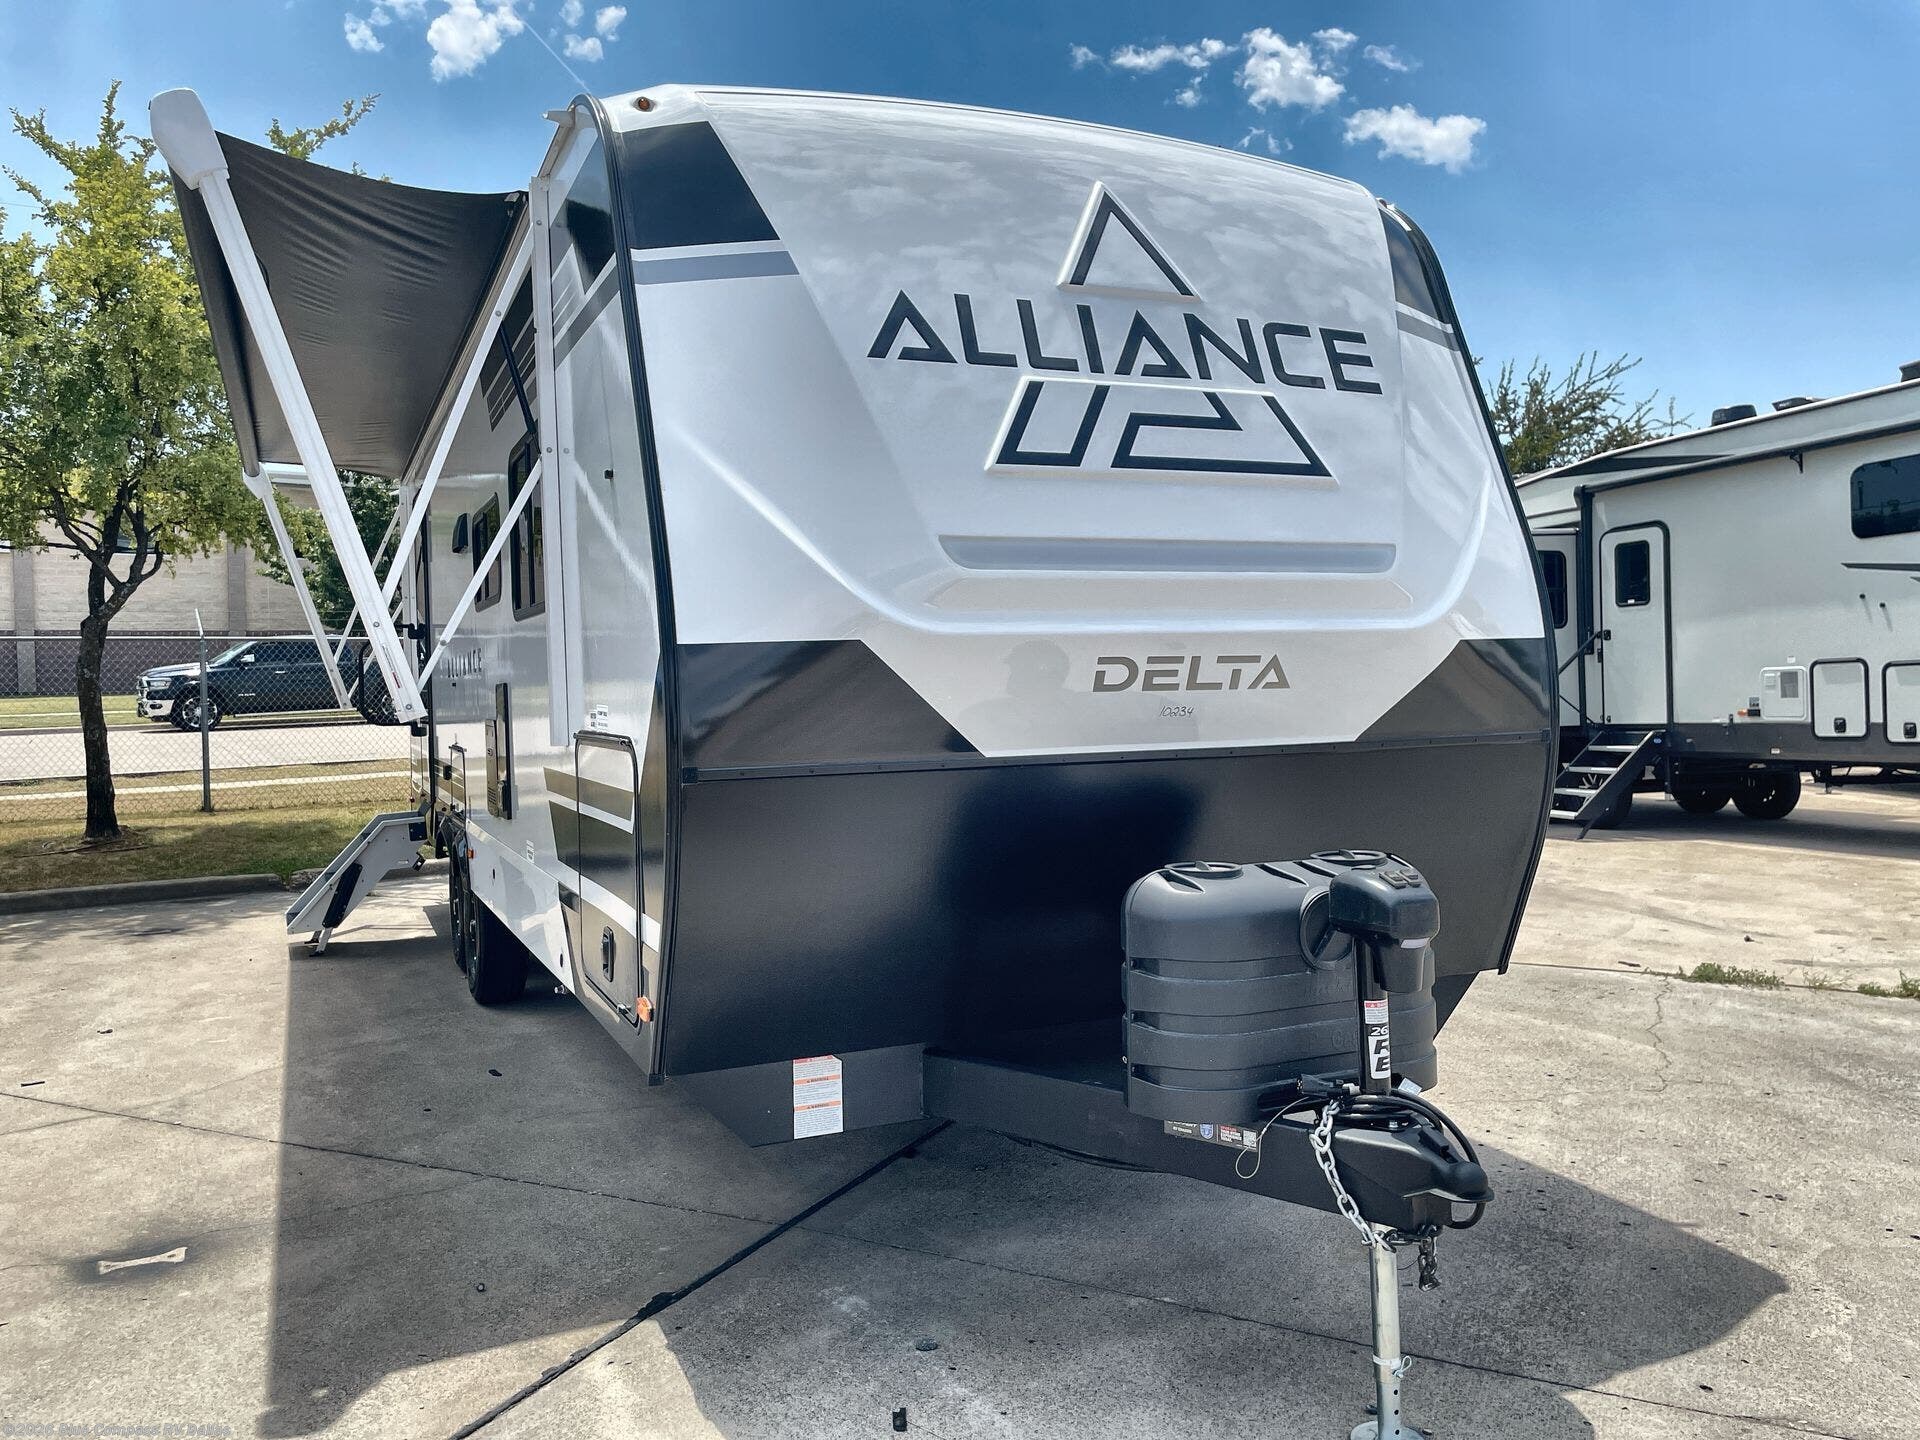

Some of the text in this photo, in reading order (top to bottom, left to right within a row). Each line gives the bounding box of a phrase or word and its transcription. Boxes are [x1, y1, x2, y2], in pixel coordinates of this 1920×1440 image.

[866, 289, 1383, 395] ALLIANCE
[1093, 654, 1290, 692] DELTA
[1160, 705, 1194, 717] 10234
